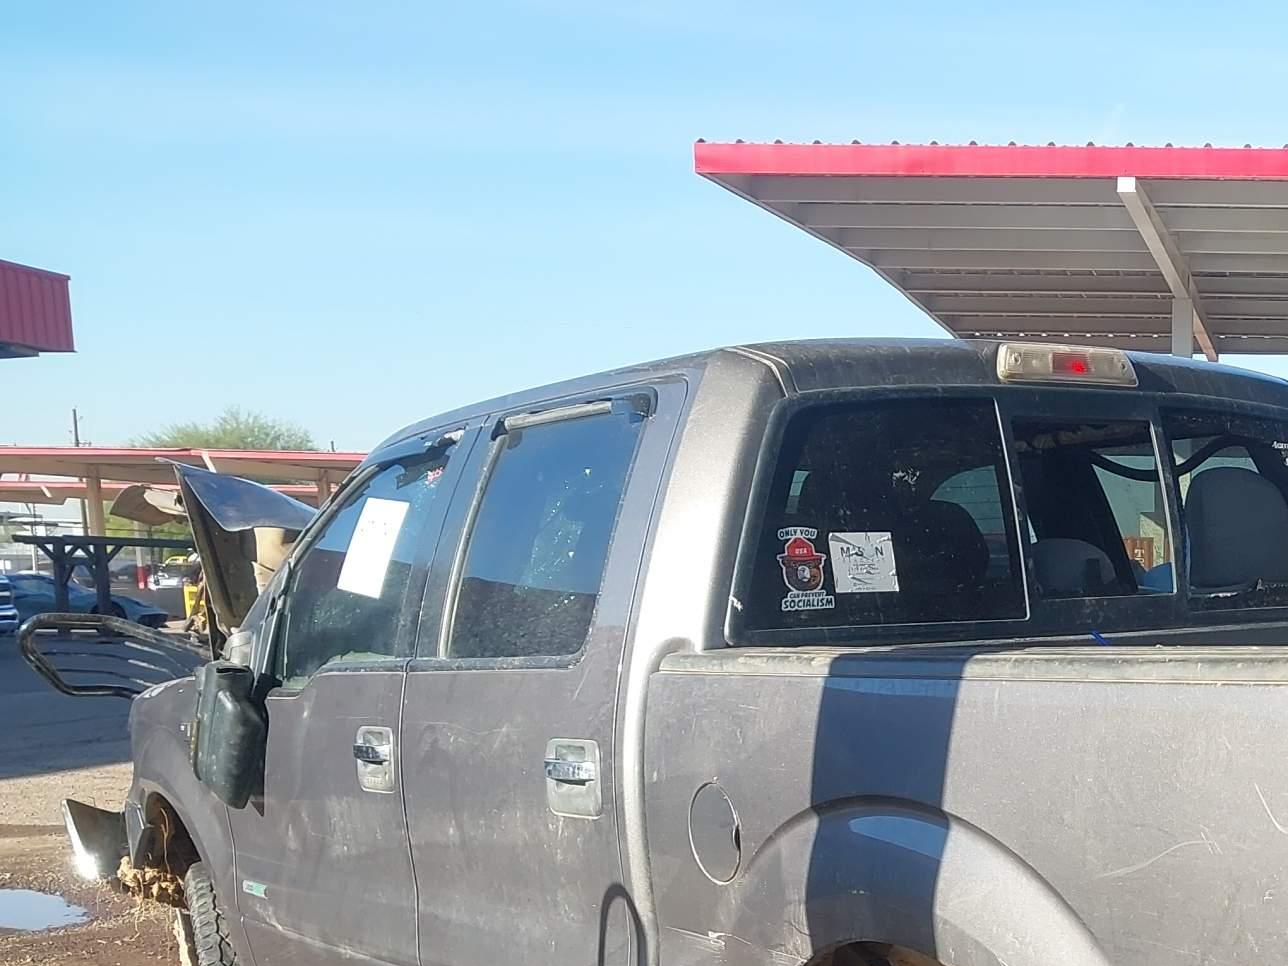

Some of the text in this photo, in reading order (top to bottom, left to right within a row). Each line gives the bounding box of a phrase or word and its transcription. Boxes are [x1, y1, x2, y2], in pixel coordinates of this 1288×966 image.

[779, 529, 816, 538] ONLY YOU
[783, 598, 833, 609] SOCIALISM
